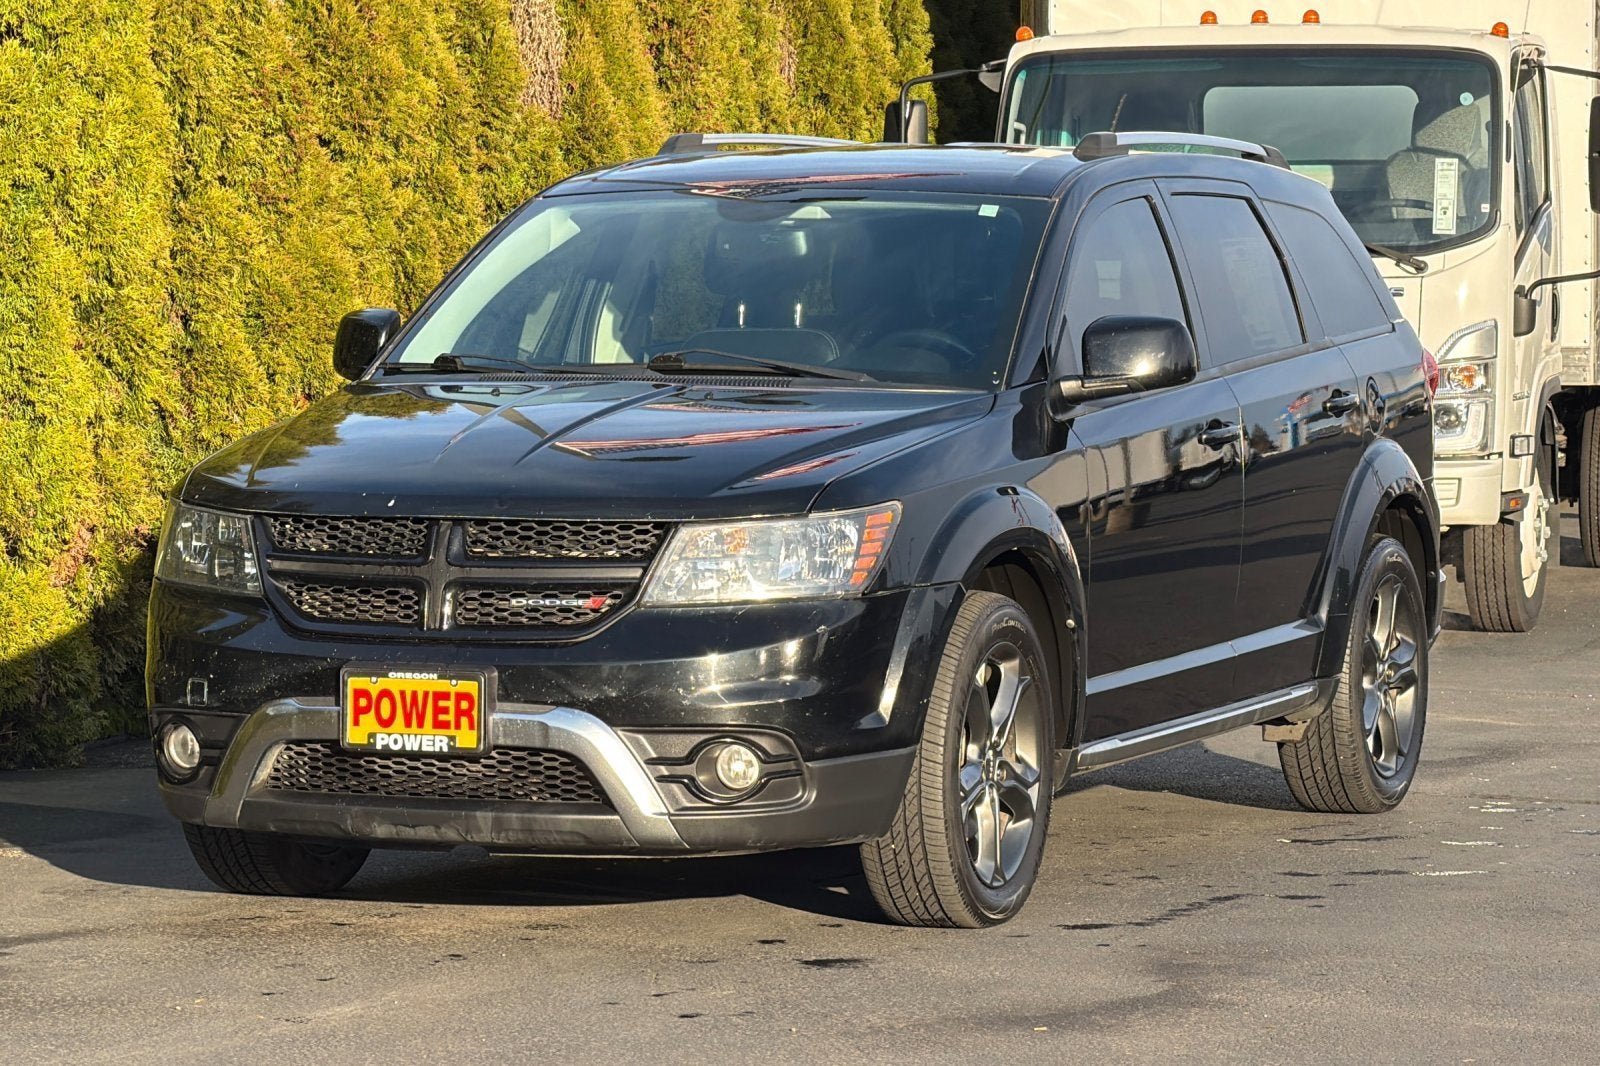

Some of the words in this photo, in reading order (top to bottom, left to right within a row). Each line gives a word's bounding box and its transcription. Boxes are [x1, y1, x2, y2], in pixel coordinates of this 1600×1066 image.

[388, 672, 438, 680] OREGON
[352, 688, 476, 730] POWER
[375, 733, 449, 752] POWER
